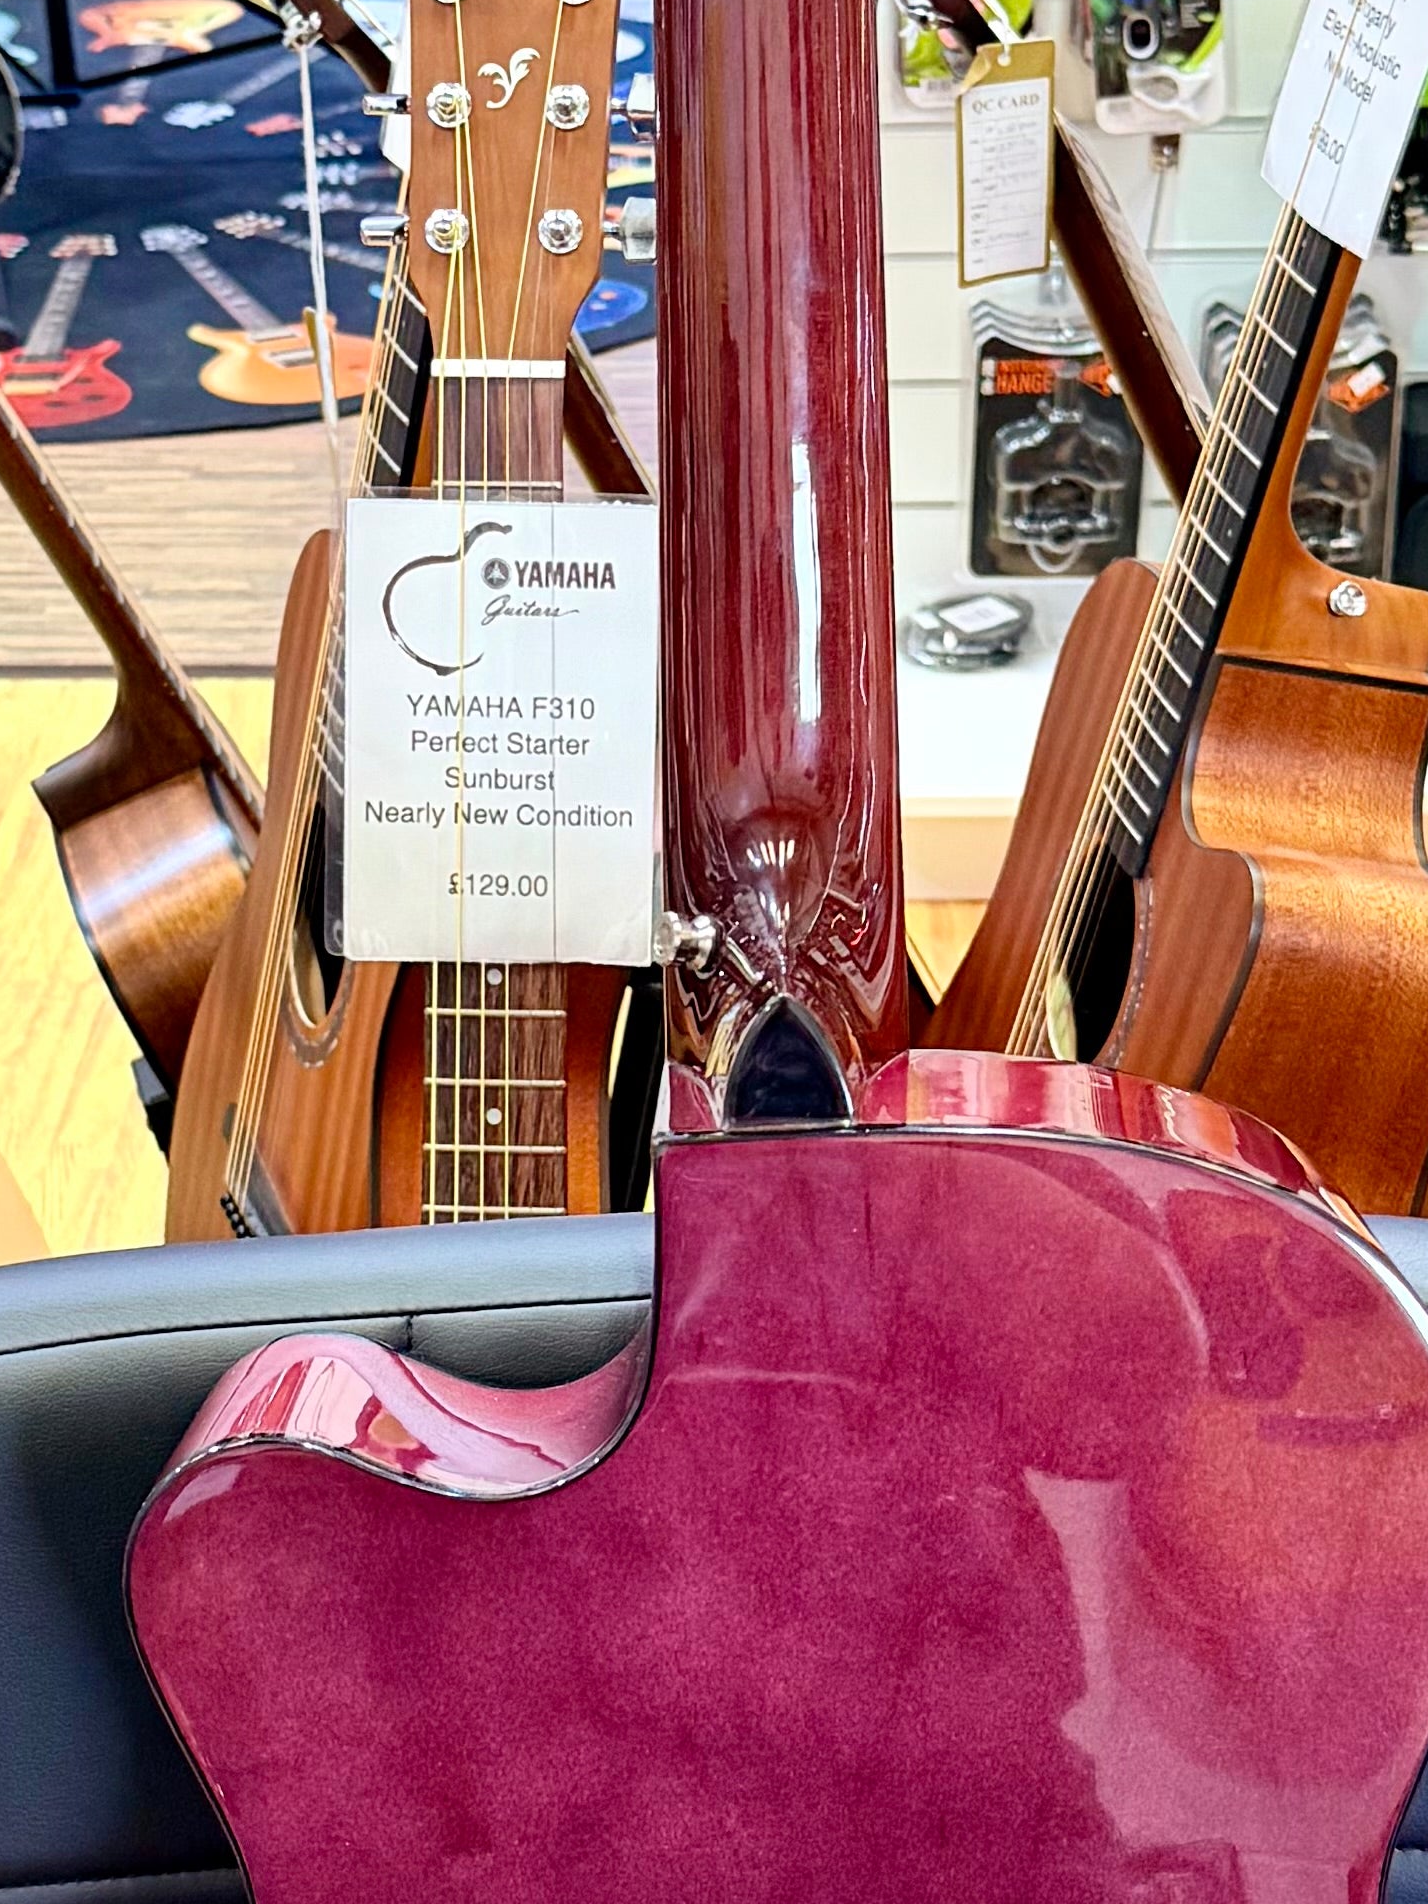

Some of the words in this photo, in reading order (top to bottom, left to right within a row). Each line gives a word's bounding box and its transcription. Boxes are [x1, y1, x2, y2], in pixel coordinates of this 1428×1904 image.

[998, 92, 1040, 112] CARD
[514, 559, 616, 590] YAMAHA
[480, 593, 580, 626] Guitars
[406, 694, 522, 720] YAMAHA
[532, 696, 596, 720] F310
[411, 730, 498, 755] Perfect
[507, 732, 590, 757] Starter
[444, 765, 555, 791] Sunburst
[365, 801, 446, 830] Nearly
[454, 802, 508, 826] New
[516, 804, 633, 828] Condition
[447, 874, 549, 899] £129.00
